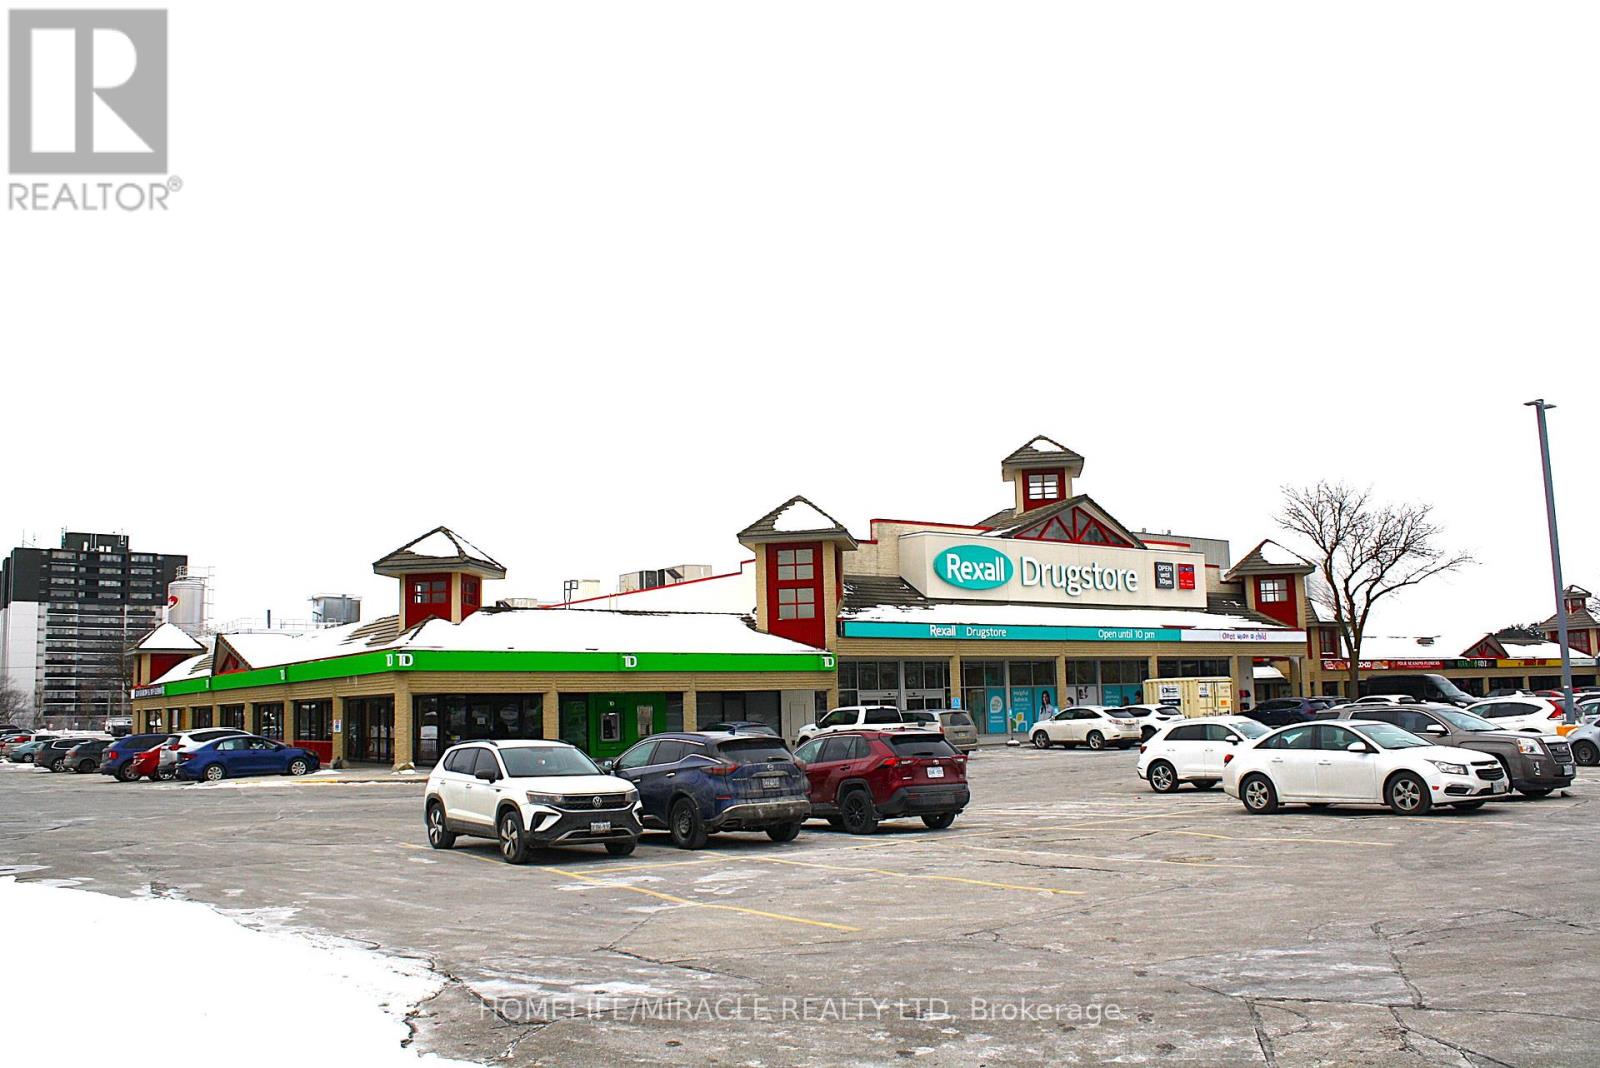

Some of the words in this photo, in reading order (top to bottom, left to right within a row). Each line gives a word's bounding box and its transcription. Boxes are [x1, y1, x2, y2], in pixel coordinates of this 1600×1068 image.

[1157, 564, 1172, 572] OPEN
[946, 553, 1005, 583] Rexall
[1020, 556, 1139, 597] Drugstore
[930, 624, 956, 637] Rexall
[966, 627, 1007, 639] Drugstore
[1098, 630, 1117, 640] Open
[1117, 630, 1133, 639] until
[1135, 630, 1143, 639] 10
[1144, 632, 1155, 640] pm
[395, 653, 413, 666] TD
[622, 655, 637, 667] TD
[821, 656, 834, 668] TD
